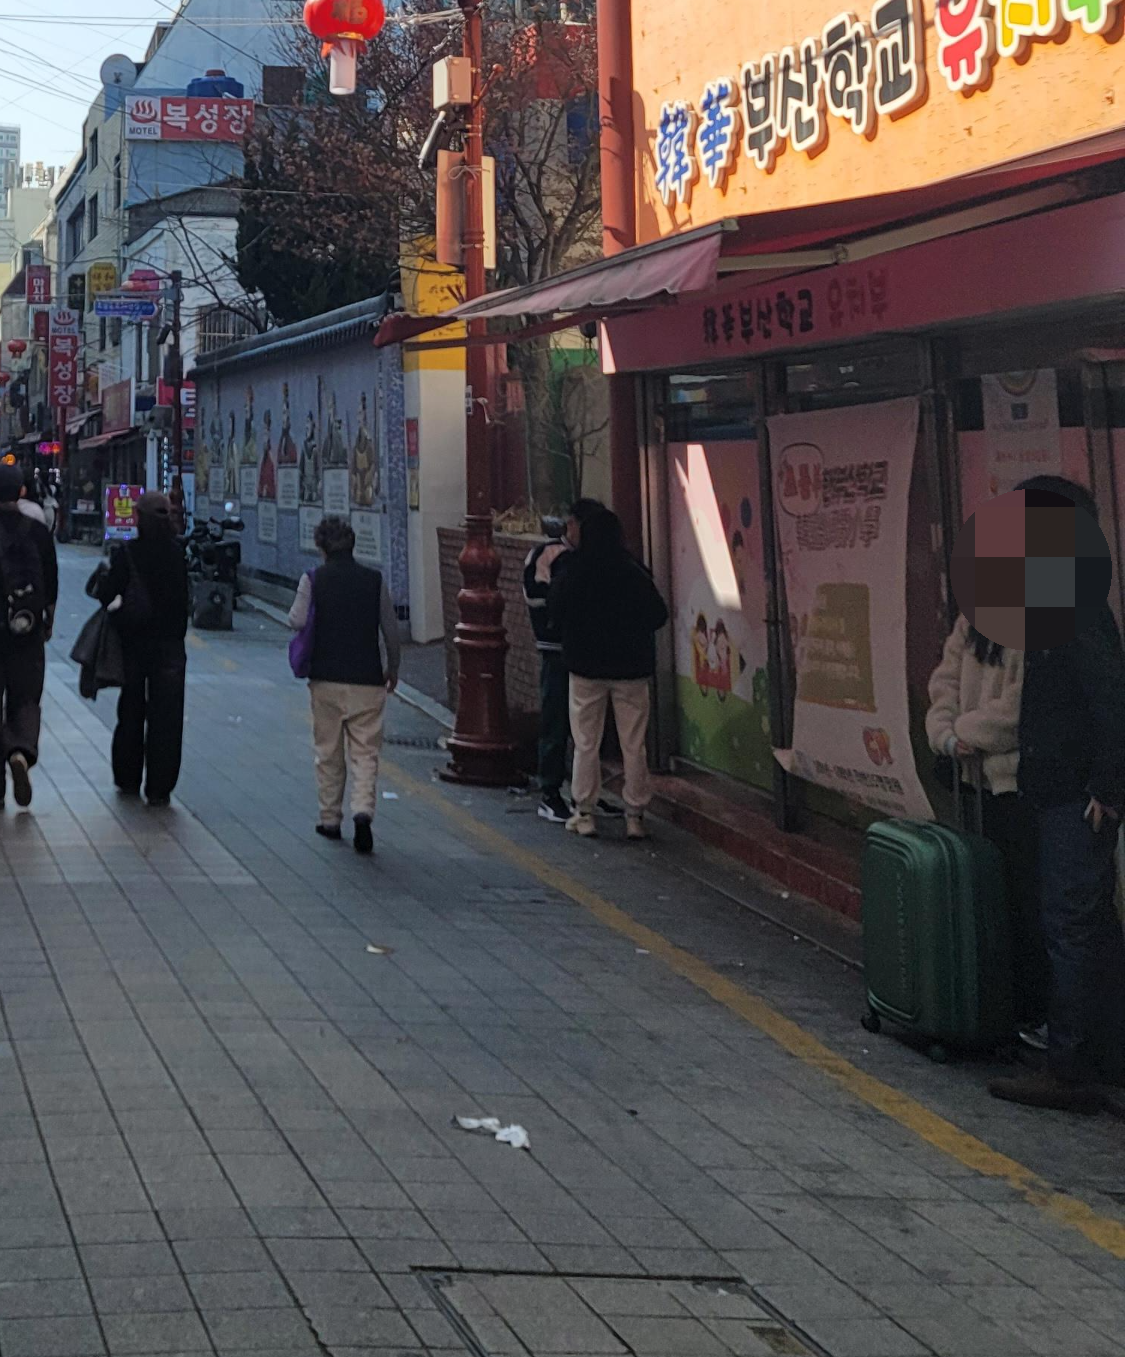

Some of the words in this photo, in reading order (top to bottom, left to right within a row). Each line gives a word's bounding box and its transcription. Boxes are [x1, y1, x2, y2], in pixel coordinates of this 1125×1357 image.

[129, 127, 158, 135] MOTEL
[163, 103, 252, 134] 복성장
[53, 338, 75, 404] 복성장
